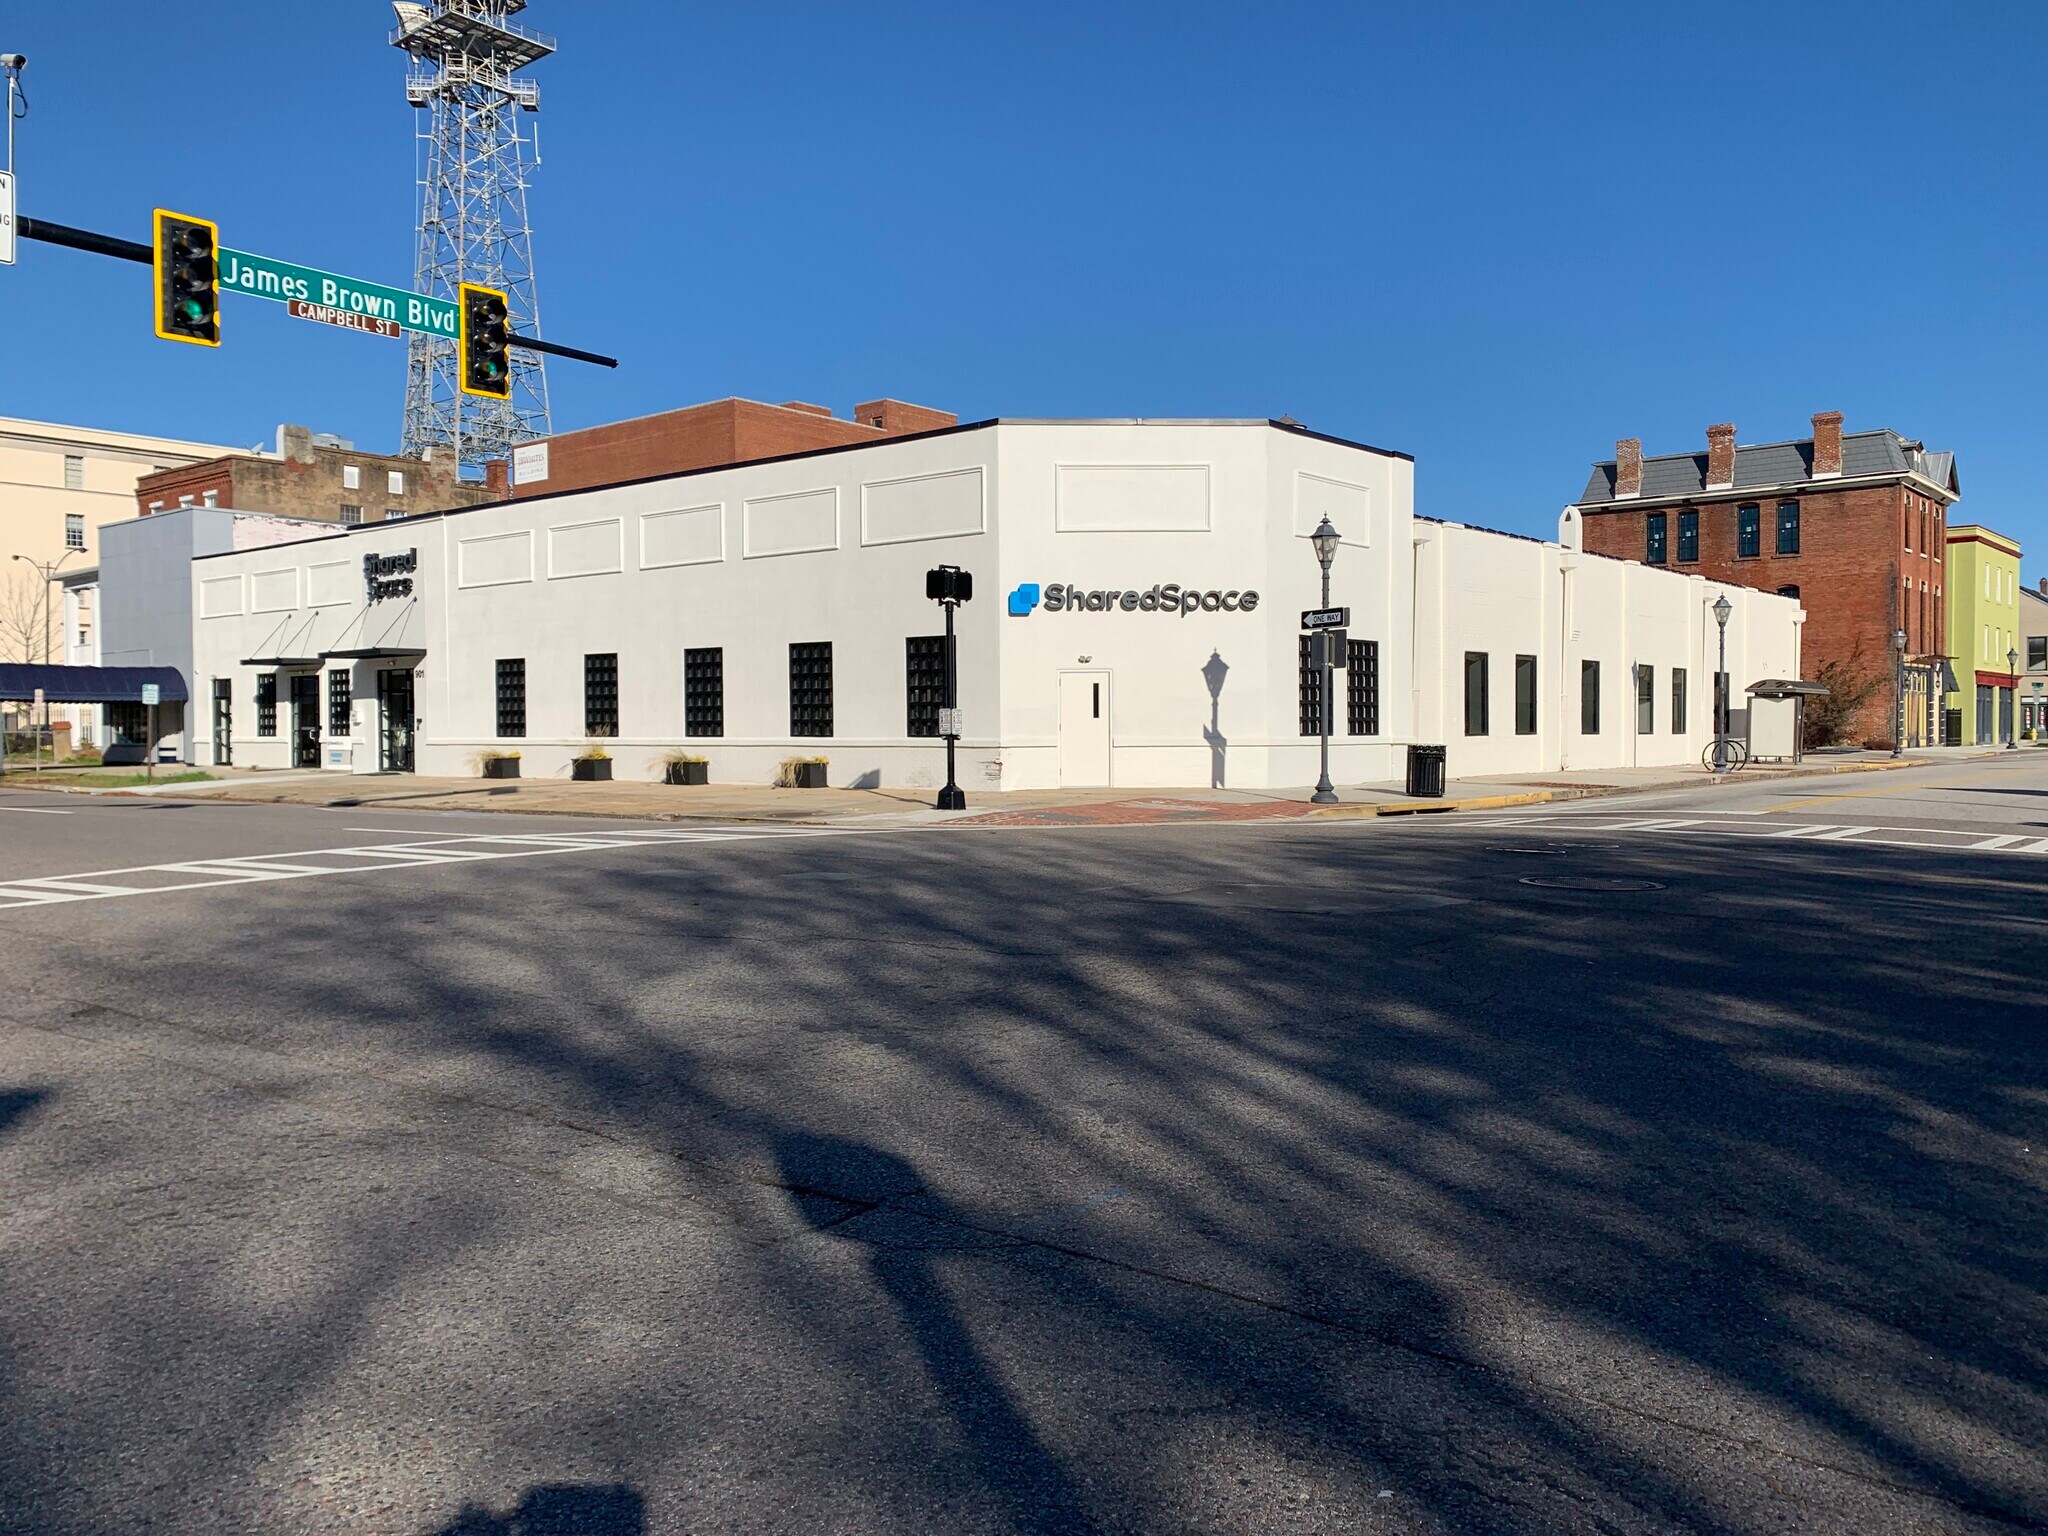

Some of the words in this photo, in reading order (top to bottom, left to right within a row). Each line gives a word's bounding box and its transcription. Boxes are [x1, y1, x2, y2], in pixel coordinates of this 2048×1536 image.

[223, 257, 308, 300] James
[322, 278, 396, 320] Brown
[408, 298, 455, 333] Blvd
[298, 302, 370, 332] CAMPBELL
[375, 319, 392, 335] ST
[363, 547, 417, 580] Shared
[367, 577, 413, 606] Space
[1043, 583, 1260, 618] SharedSpace
[1313, 614, 1325, 623] ONE
[1326, 613, 1339, 622] WAY
